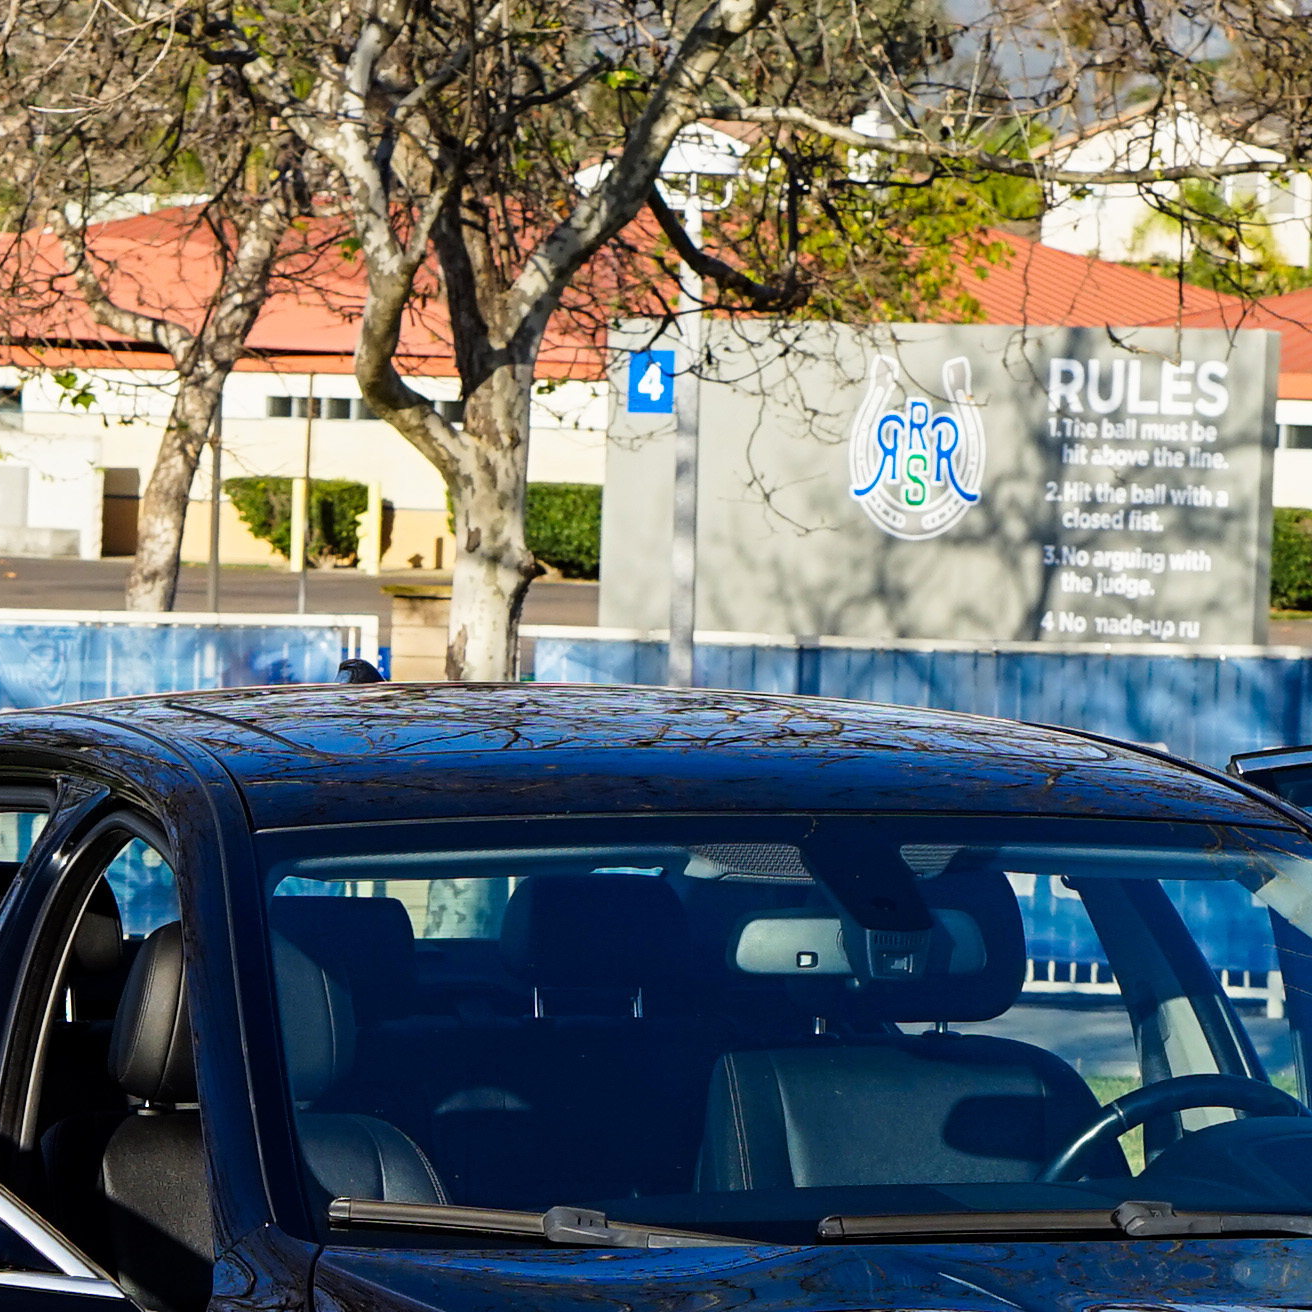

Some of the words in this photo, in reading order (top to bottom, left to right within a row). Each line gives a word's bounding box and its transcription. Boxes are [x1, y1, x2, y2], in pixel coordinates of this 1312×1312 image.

[637, 361, 664, 401] 4
[1047, 357, 1230, 417] RULES
[1101, 418, 1137, 440] ball
[1140, 423, 1189, 442] must
[1191, 421, 1218, 443] be
[1062, 444, 1089, 465] hit
[1090, 444, 1150, 468] above
[1153, 448, 1186, 468] the
[1189, 447, 1230, 469] line.
[1045, 481, 1062, 503] 2.
[1063, 483, 1092, 504] Hit
[1095, 483, 1128, 505] the
[1131, 484, 1167, 506] ball
[1170, 486, 1213, 508] with
[1215, 492, 1229, 507] a
[1062, 507, 1124, 531] closed
[1127, 509, 1165, 532] fist.
[1043, 545, 1060, 566] 3.
[1061, 546, 1090, 567] No
[1092, 548, 1166, 573] arguing
[1169, 550, 1212, 572] with
[1060, 573, 1093, 594] the
[1095, 574, 1156, 599] judge.
[1058, 612, 1087, 634] No
